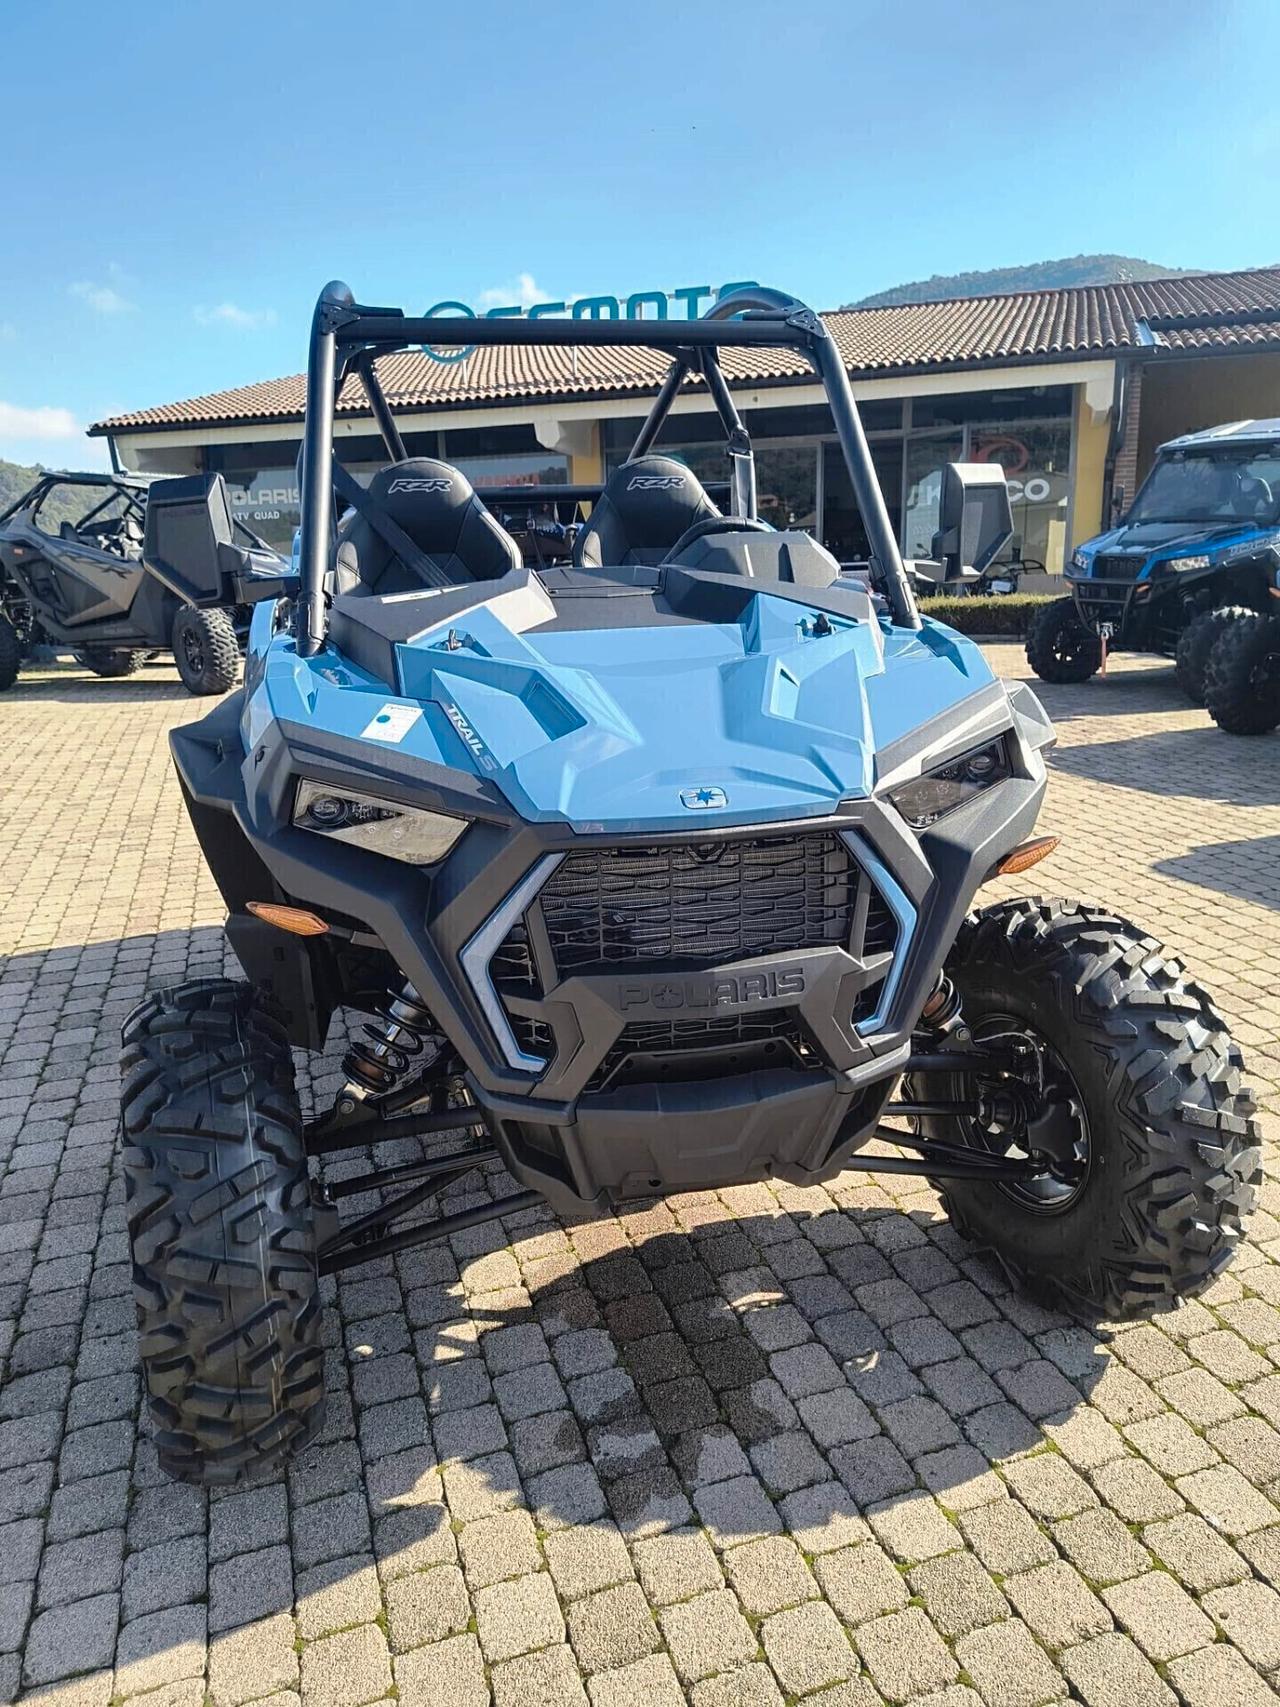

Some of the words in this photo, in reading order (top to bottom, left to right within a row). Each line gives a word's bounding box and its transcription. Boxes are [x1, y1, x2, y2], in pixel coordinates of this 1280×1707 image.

[388, 478, 452, 494] RZR
[626, 475, 686, 491] RZR
[254, 511, 280, 520] QUAD
[447, 703, 484, 757] TRAIL
[618, 967, 806, 1011] POLARIS
